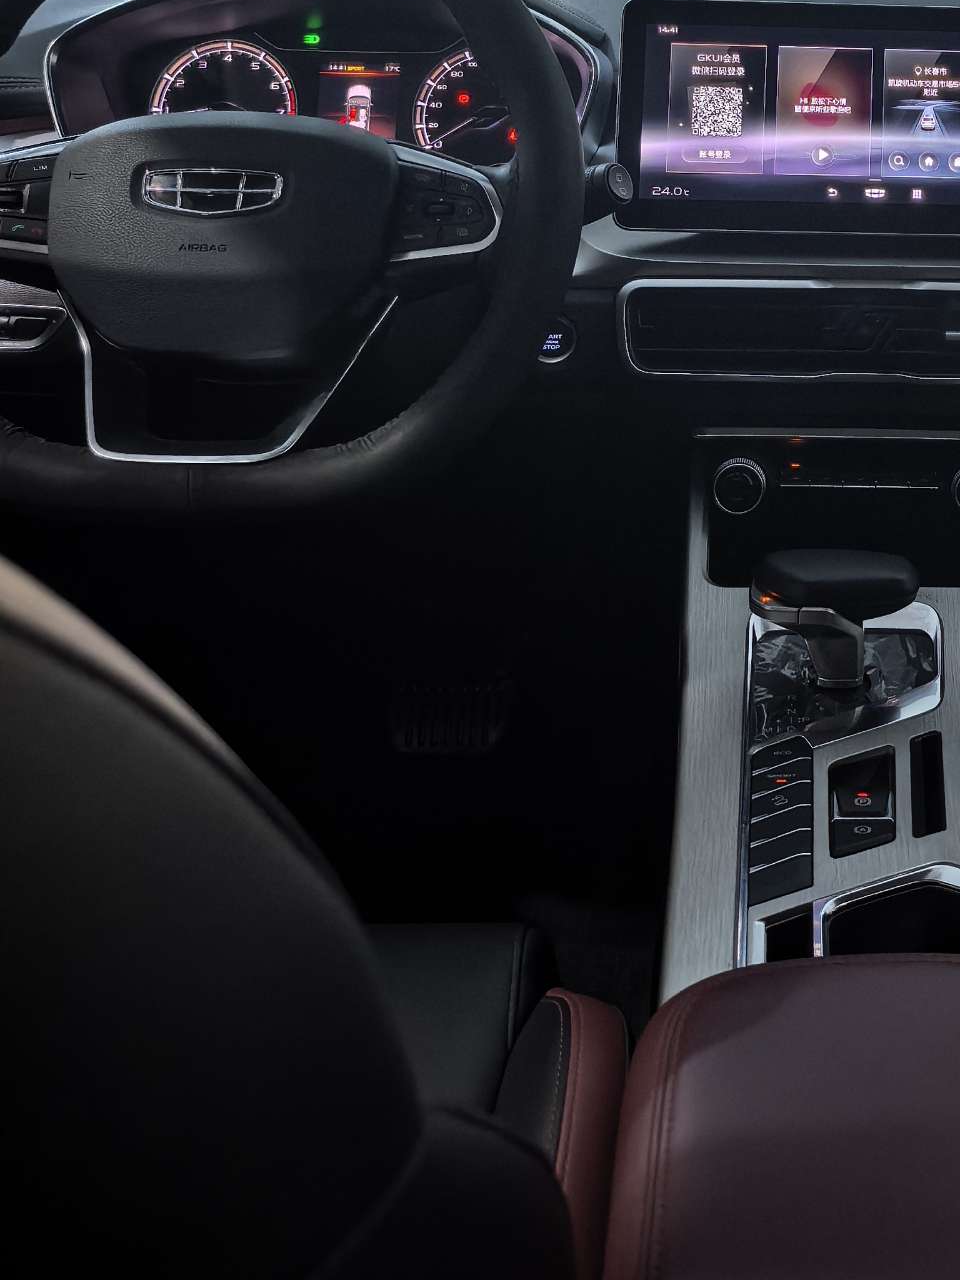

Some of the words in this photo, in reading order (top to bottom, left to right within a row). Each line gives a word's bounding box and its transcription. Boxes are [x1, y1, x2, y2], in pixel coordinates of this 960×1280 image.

[224, 54, 233, 62] 4
[697, 53, 741, 64] GKUI会员
[199, 61, 208, 69] 3
[251, 62, 260, 70] 5
[450, 70, 464, 78] 80
[691, 65, 745, 76] 微信扫码登录
[924, 66, 948, 76] 长春市
[176, 79, 185, 88] 2
[270, 82, 280, 90] 6
[430, 101, 443, 109] 40
[434, 139, 443, 149] 0
[178, 243, 228, 253] AIRBAG
